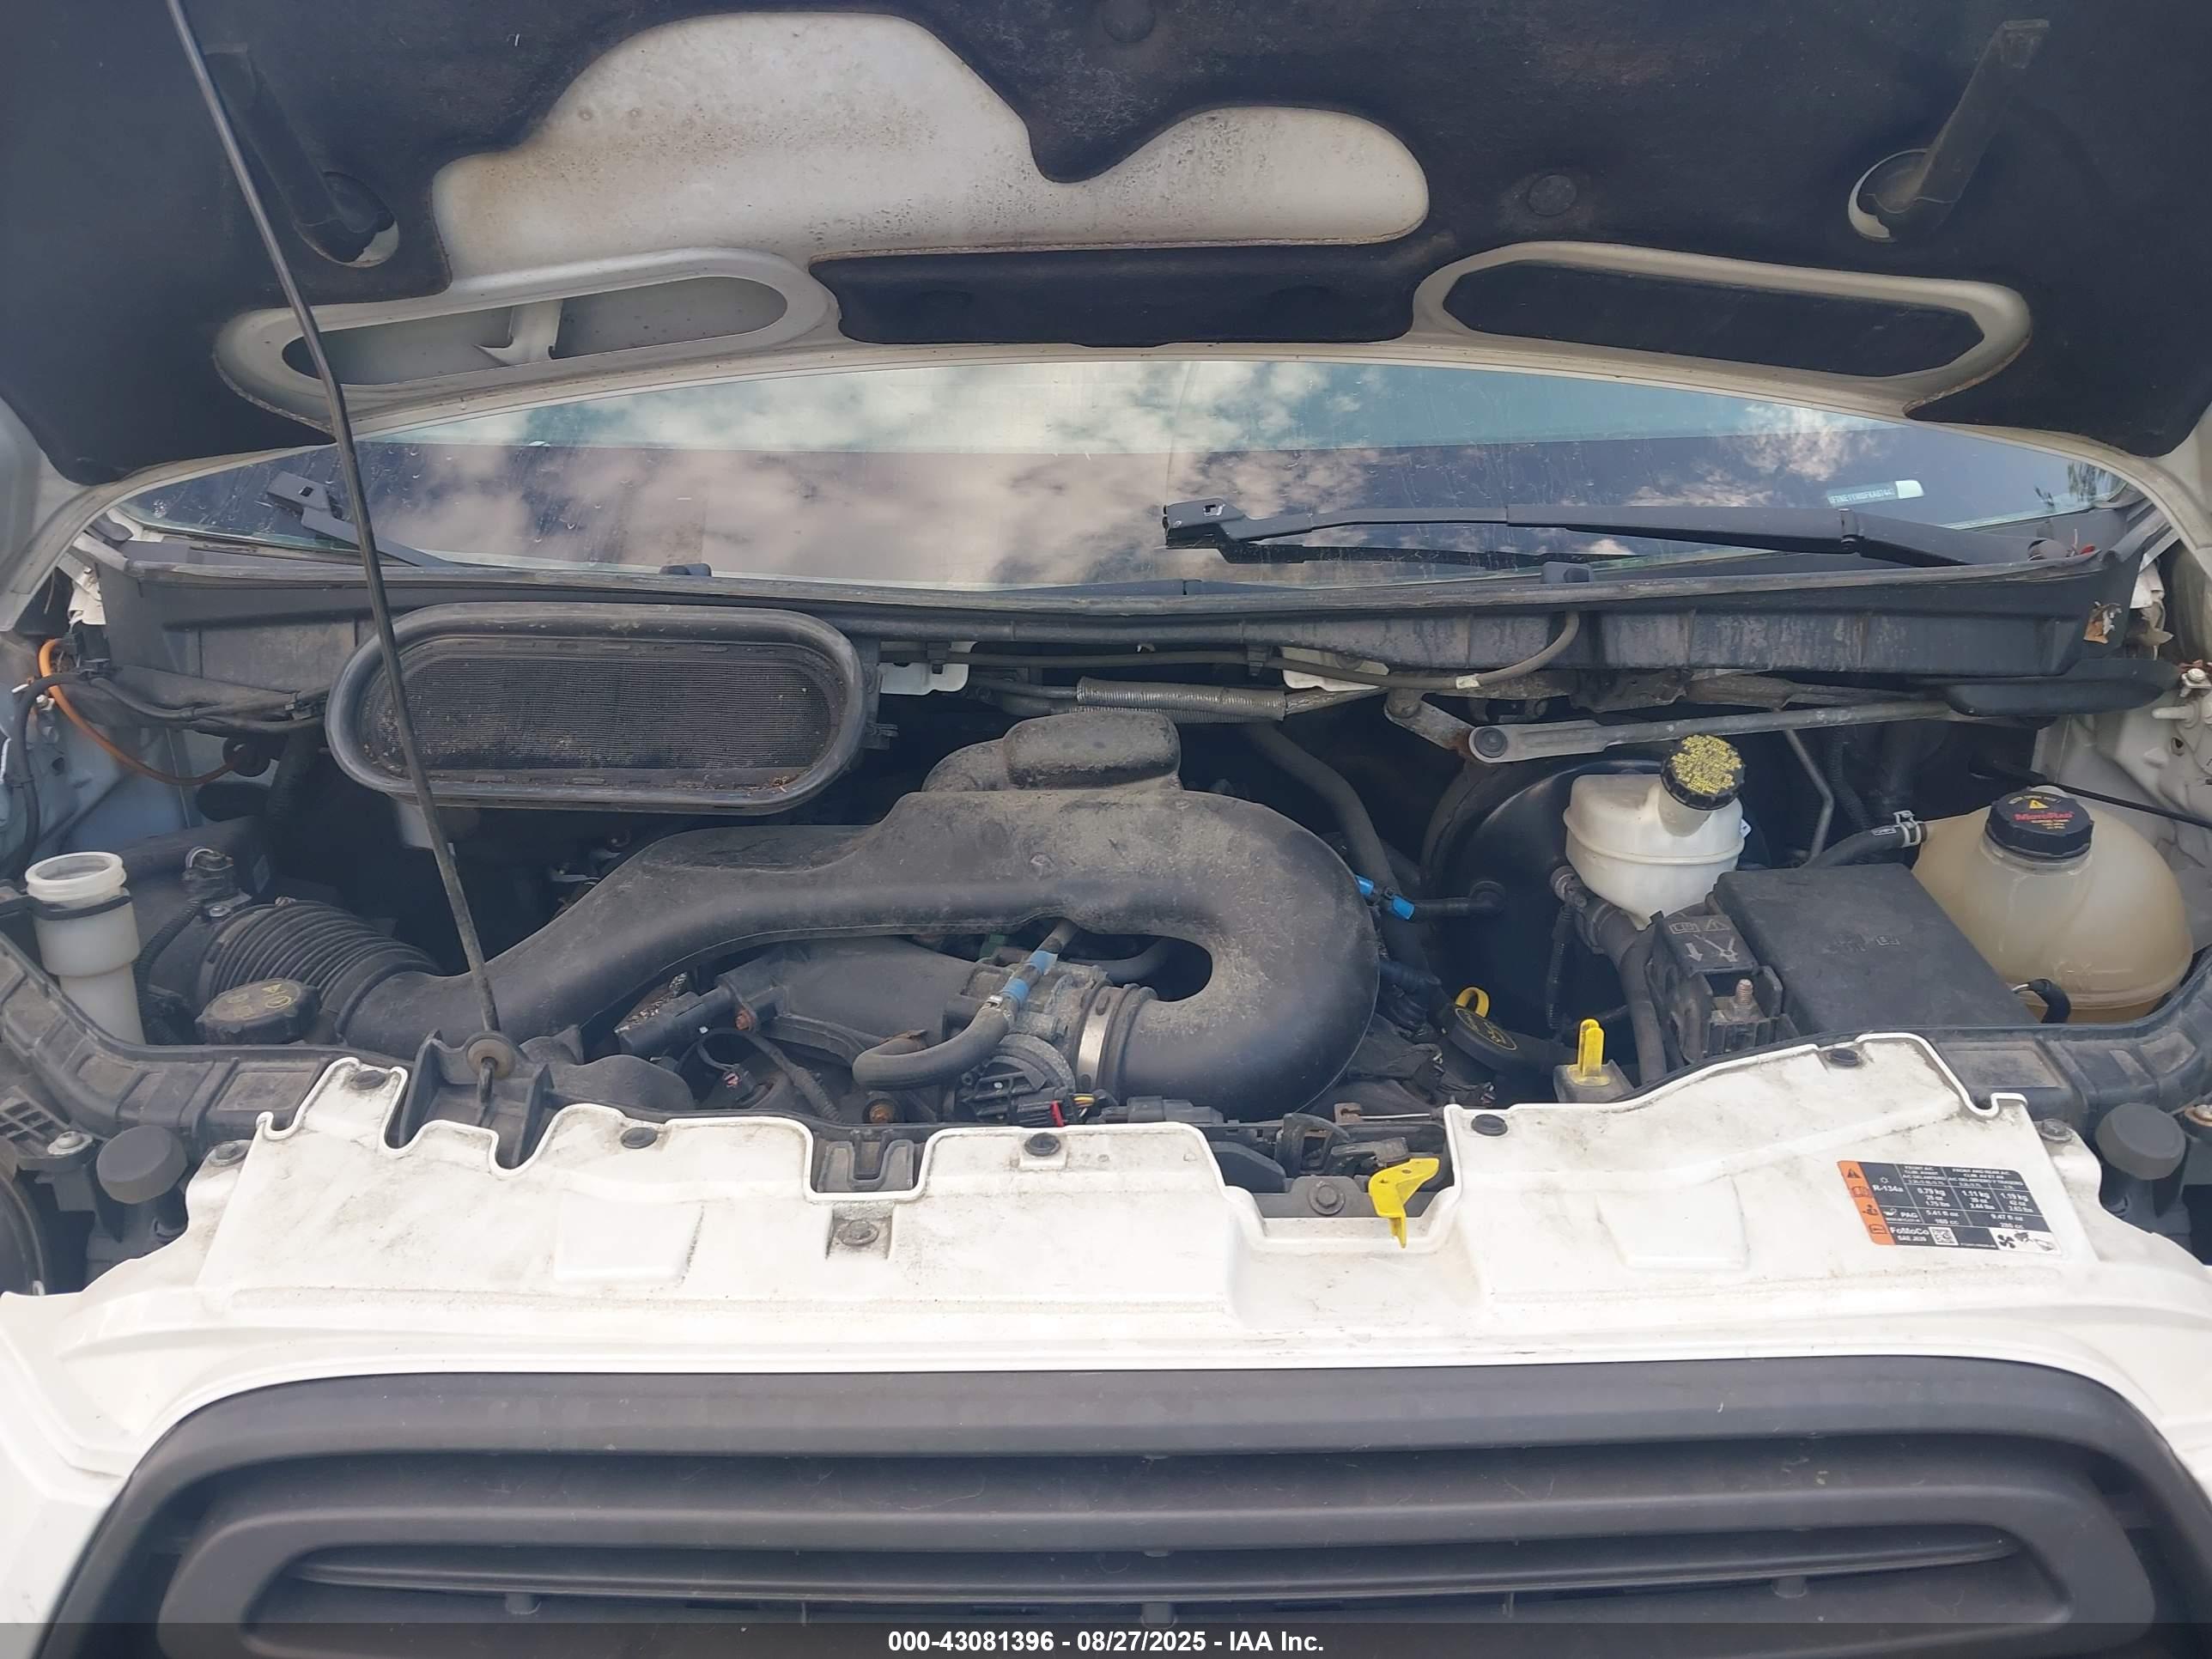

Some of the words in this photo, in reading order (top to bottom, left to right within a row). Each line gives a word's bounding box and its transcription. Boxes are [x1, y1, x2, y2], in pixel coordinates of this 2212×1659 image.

[1872, 1184, 1904, 1193] R-134a
[1978, 1191, 1990, 1200] kg
[2017, 1194, 2028, 1202] kg
[1889, 1226, 1929, 1235] FoMoCo
